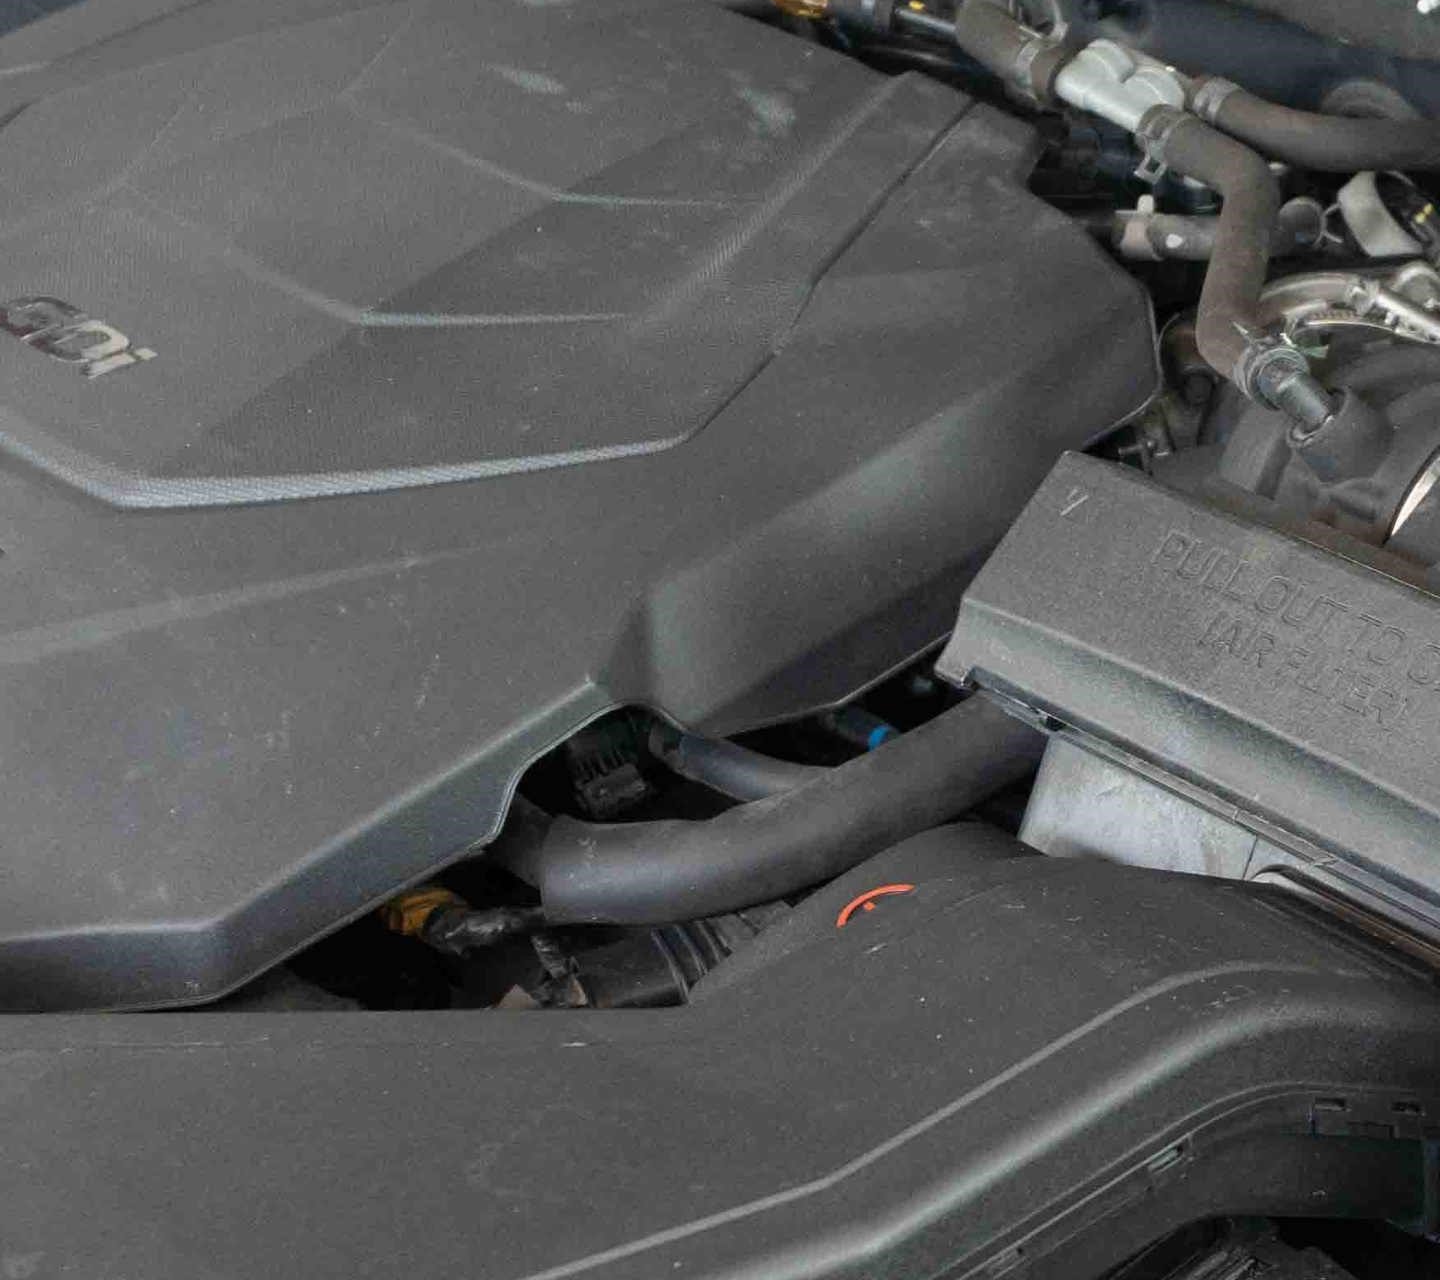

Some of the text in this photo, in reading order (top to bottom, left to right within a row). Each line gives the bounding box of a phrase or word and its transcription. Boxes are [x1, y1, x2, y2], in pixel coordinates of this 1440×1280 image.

[1150, 527, 1251, 602] PULL
[1257, 574, 1348, 637] OUT
[1350, 612, 1406, 666] TO
